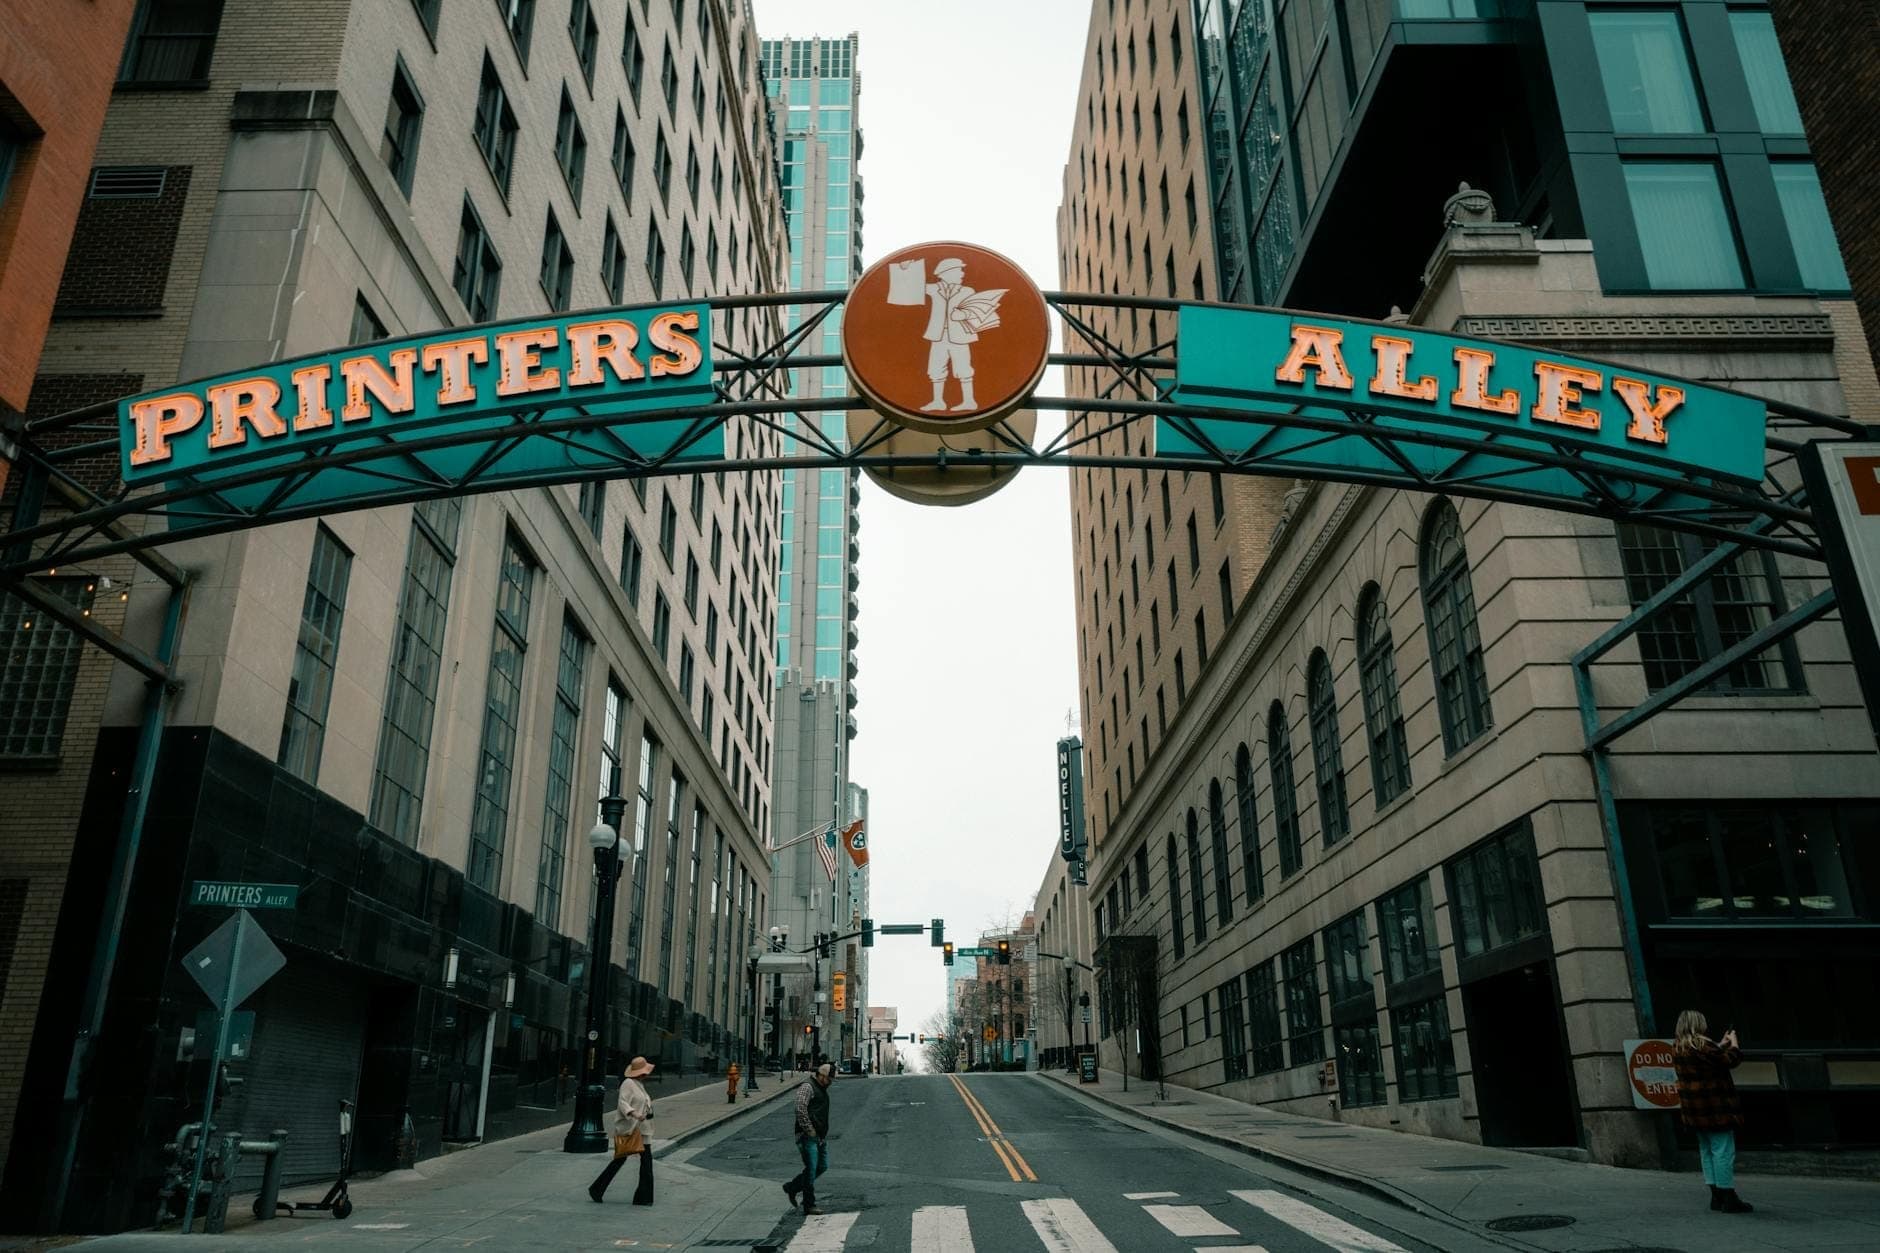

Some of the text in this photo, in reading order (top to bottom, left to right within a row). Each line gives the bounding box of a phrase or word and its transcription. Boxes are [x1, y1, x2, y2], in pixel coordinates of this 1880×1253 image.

[128, 311, 1685, 466] PRINTERS ALLEY
[1060, 752, 1070, 842] NOELLE
[198, 885, 288, 905] PRINTERS ALLEY
[1635, 1053, 1673, 1064] DO NO
